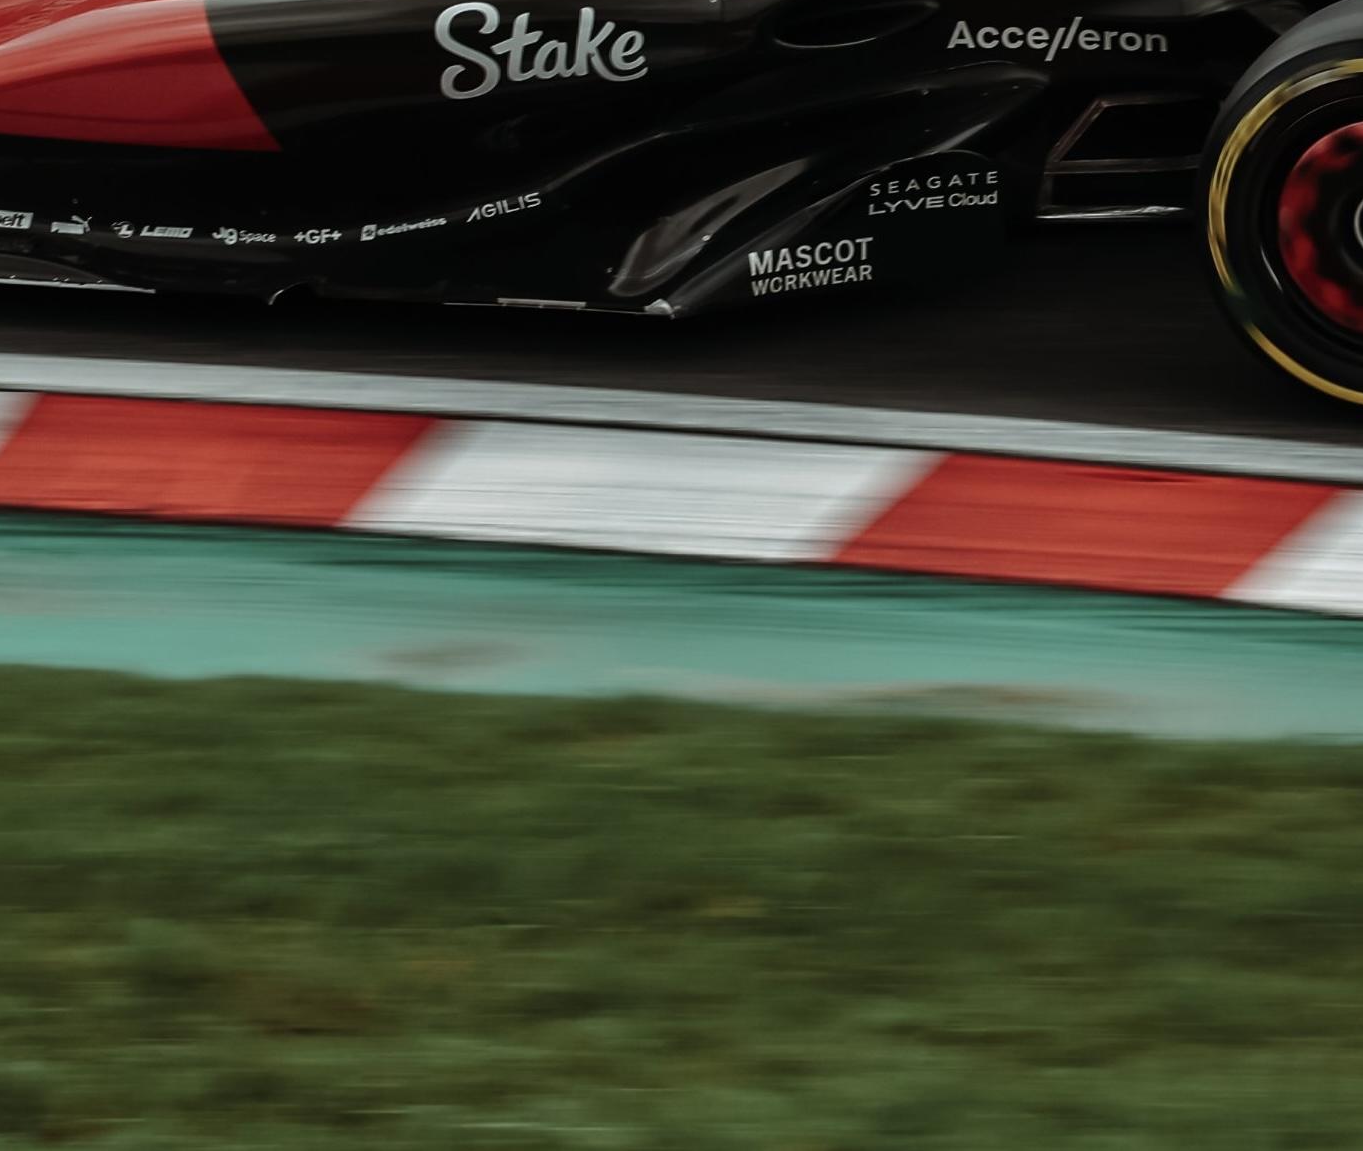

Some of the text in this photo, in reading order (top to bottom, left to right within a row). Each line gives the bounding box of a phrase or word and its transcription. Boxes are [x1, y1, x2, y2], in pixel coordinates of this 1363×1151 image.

[435, 2, 648, 100] Stake
[870, 171, 999, 196] SEAGATE
[467, 192, 541, 222] AGILIS
[869, 191, 998, 216] LYVE Cloud
[748, 237, 874, 277] MASCOT
[751, 264, 874, 296] WORKWEAR
